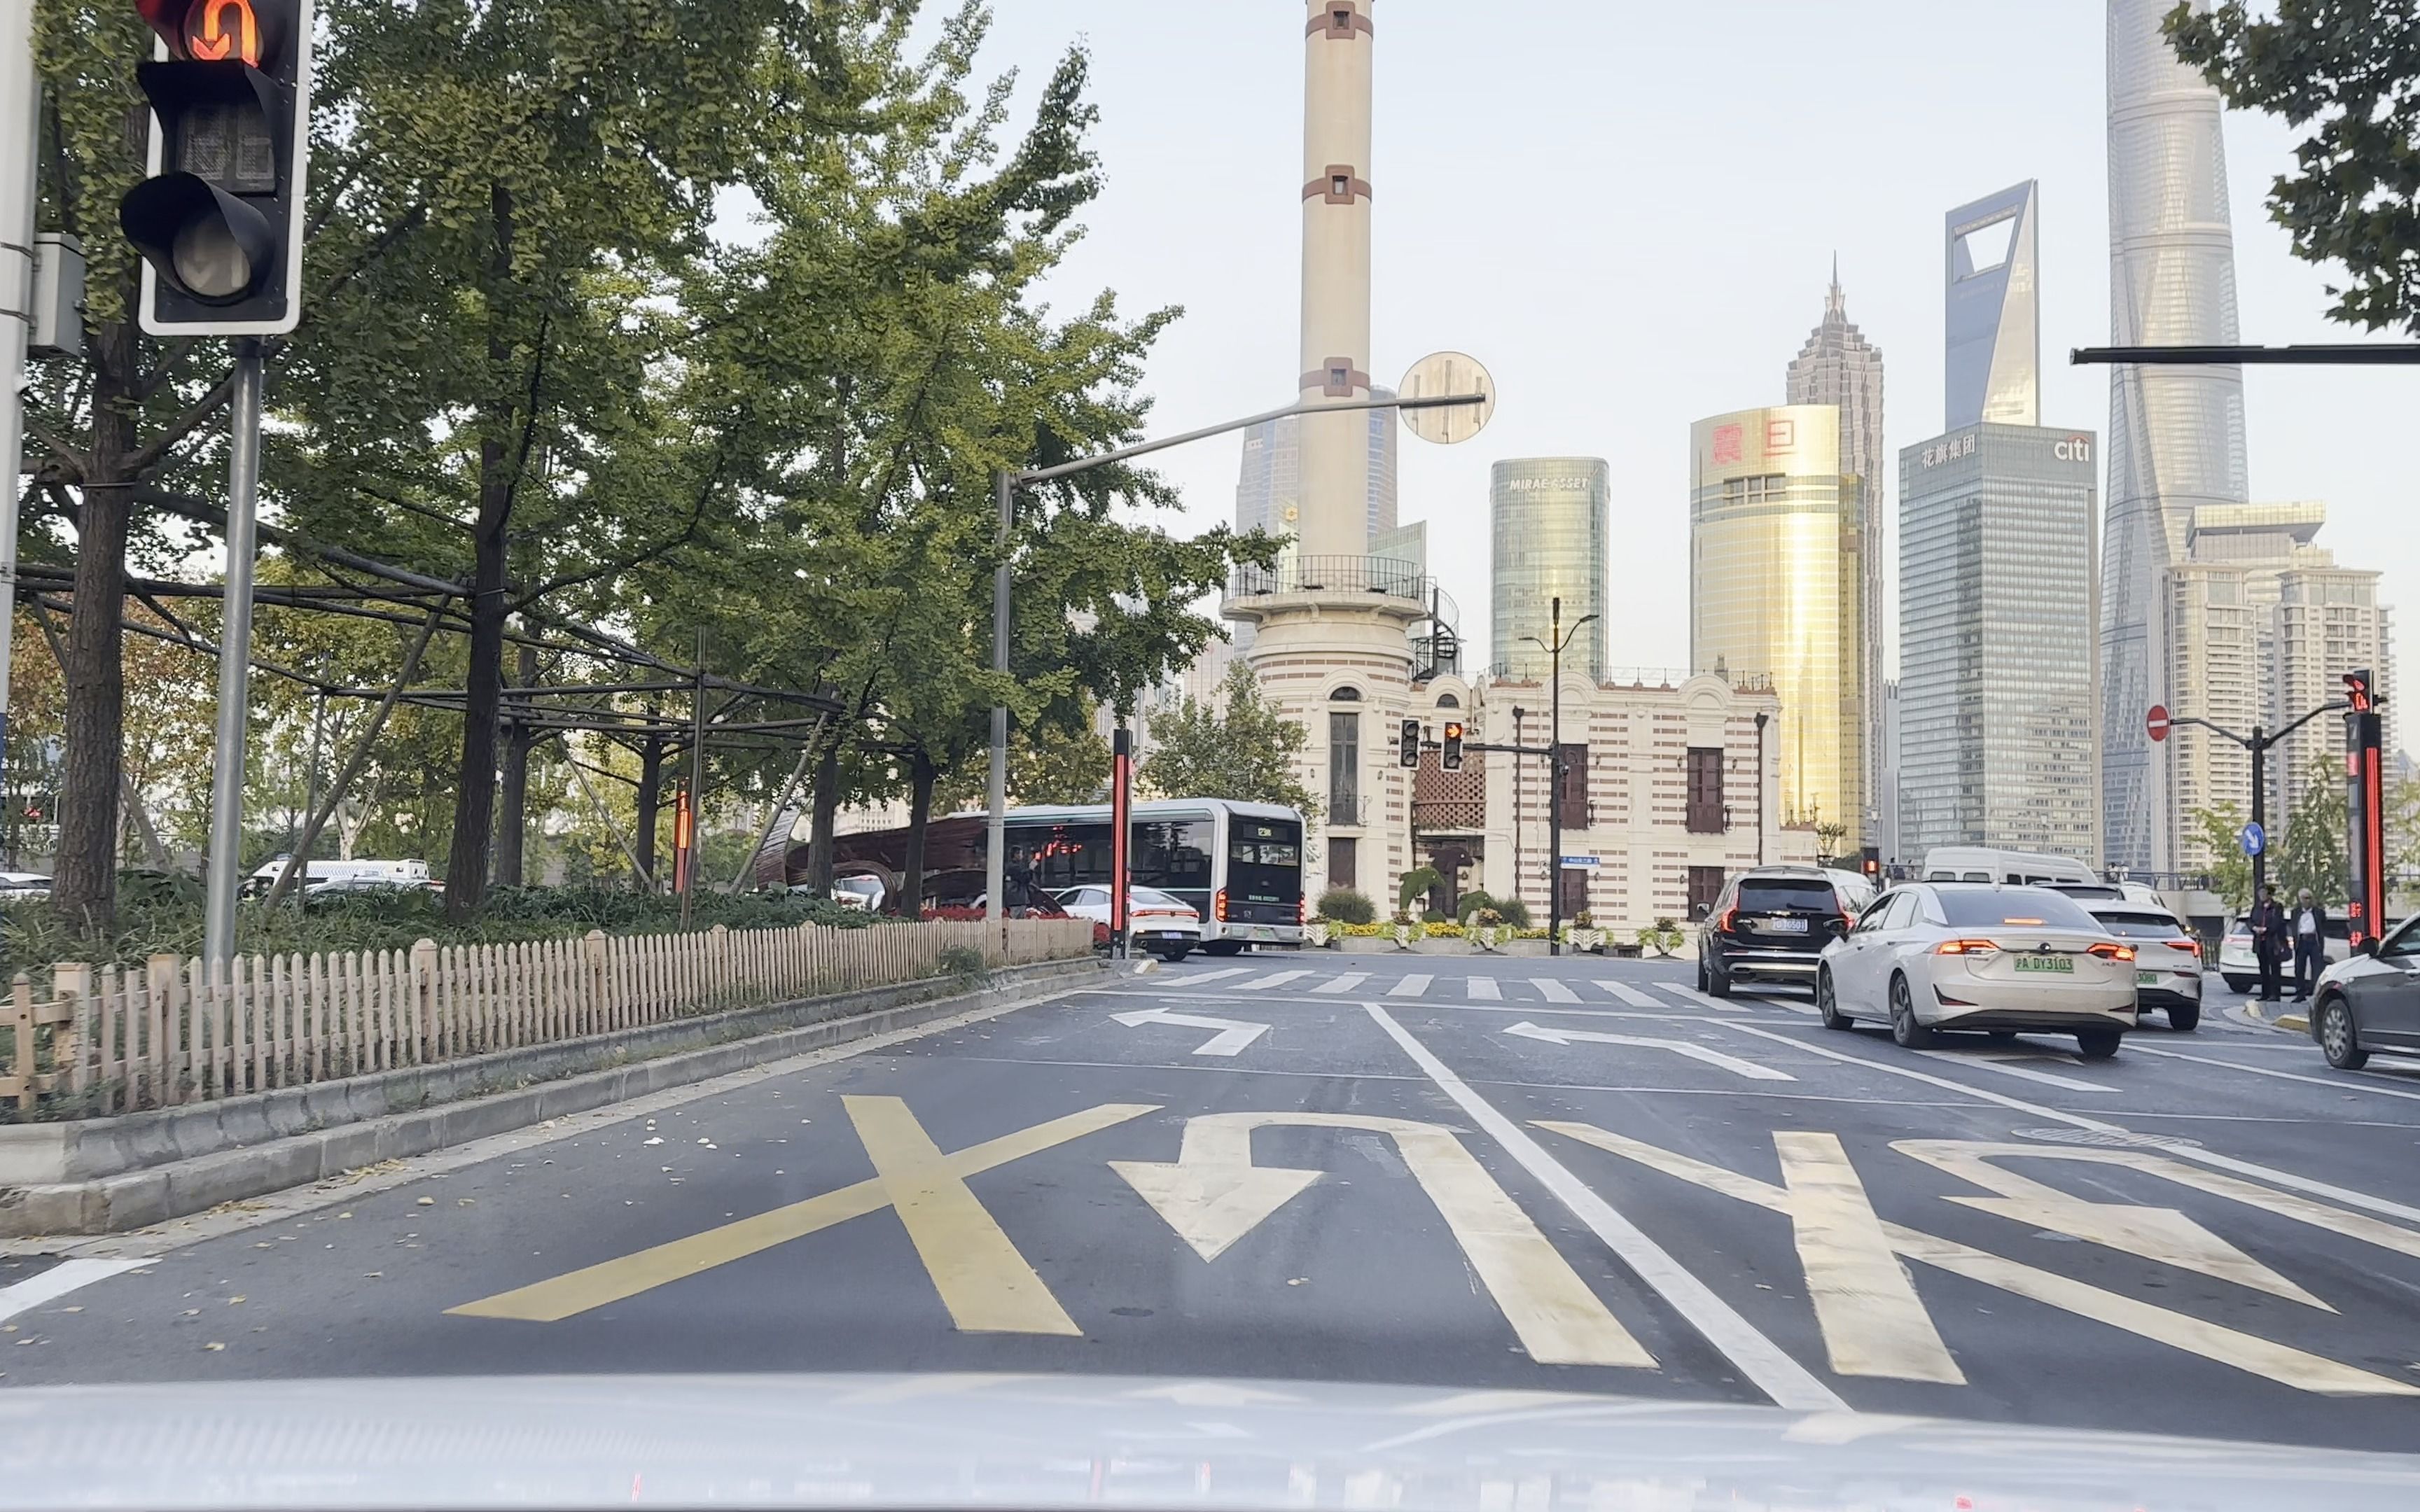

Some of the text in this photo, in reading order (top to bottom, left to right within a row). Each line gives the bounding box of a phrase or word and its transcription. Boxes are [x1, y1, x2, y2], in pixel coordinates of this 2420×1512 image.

[1921, 433, 1975, 469] 花旗集团
[2054, 438, 2089, 462] citi
[1510, 477, 1589, 490] MIRAE ASSET
